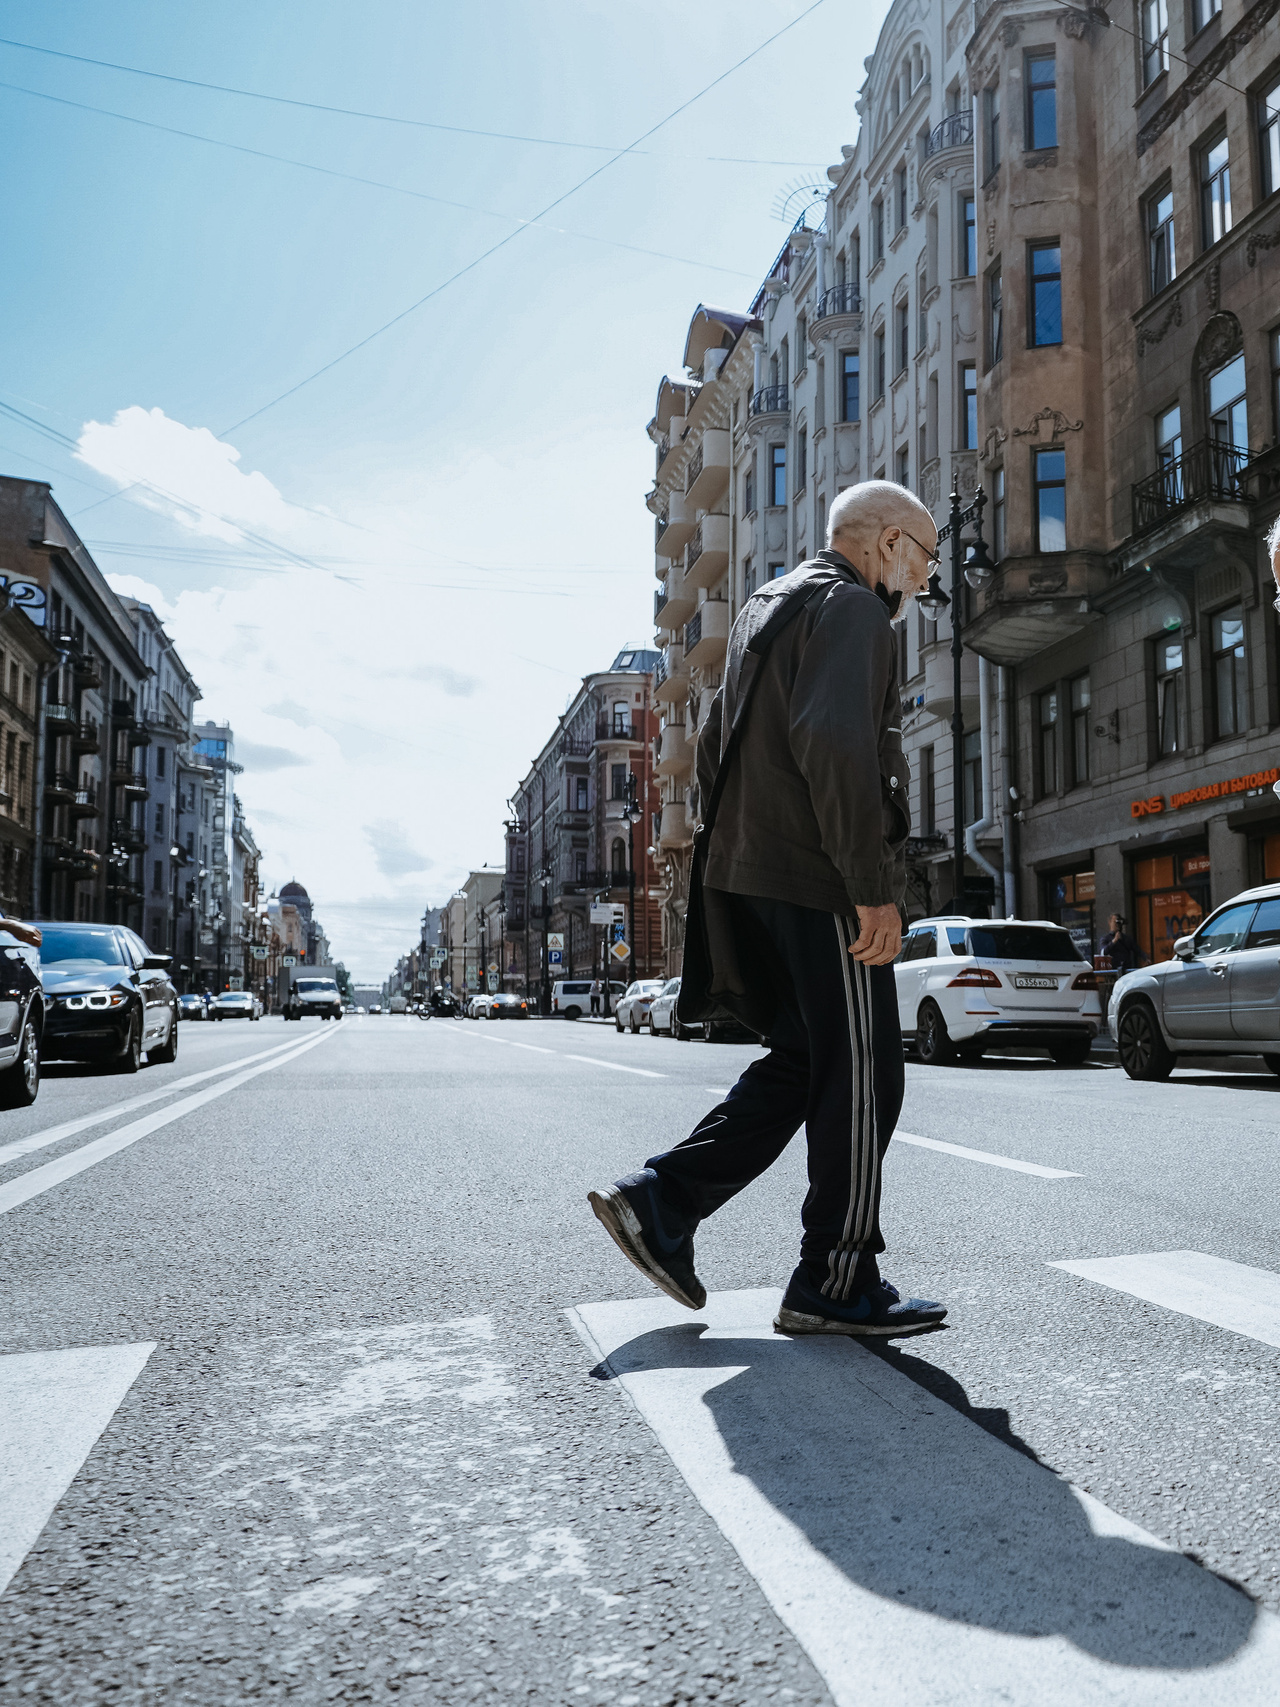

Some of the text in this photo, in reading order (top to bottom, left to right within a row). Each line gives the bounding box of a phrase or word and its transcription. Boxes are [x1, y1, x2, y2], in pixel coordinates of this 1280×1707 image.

[1170, 783, 1219, 808] ЦИФРОВАЯ
[1220, 780, 1230, 795] И
[1230, 768, 1278, 793] БЫТОВАЯ
[1131, 796, 1163, 818] DNS
[552, 952, 560, 963] P
